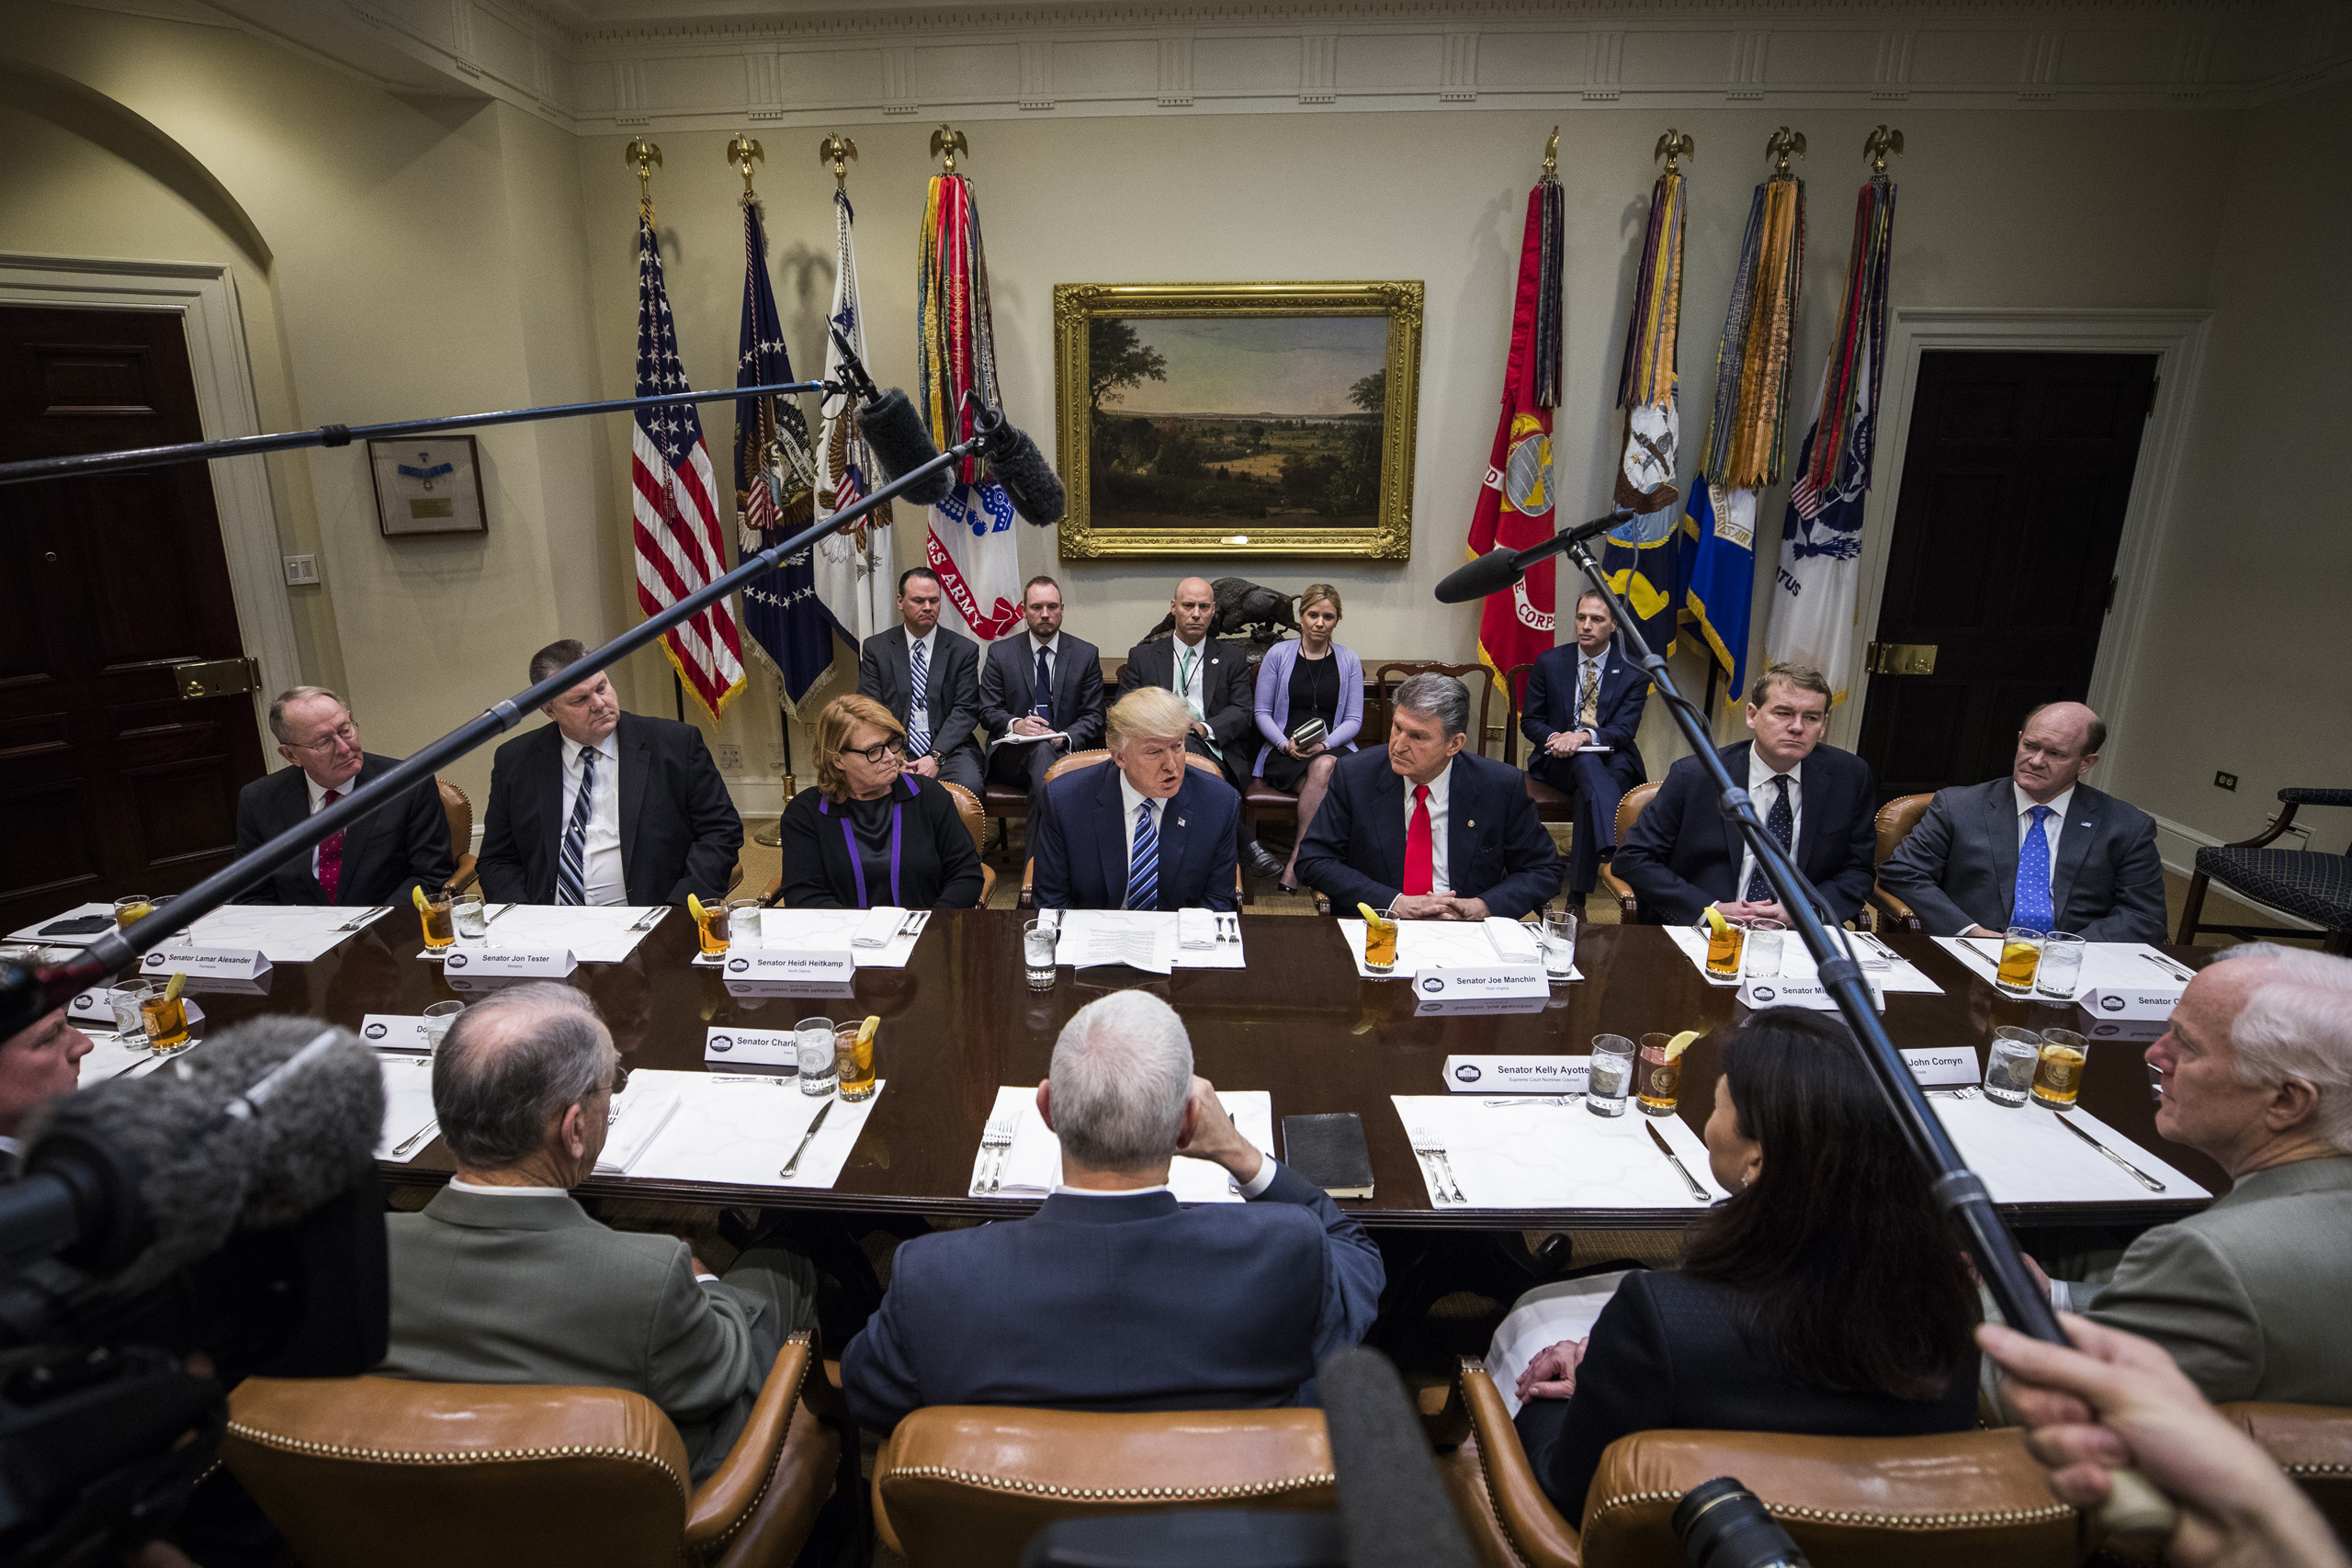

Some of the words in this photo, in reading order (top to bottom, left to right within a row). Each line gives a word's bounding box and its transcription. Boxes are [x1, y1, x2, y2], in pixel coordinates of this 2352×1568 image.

[954, 275, 964, 340] LEXINGTON
[955, 348, 964, 374] 1775
[941, 572, 984, 629] ARMY
[168, 953, 194, 963] Senator
[195, 954, 217, 964] Lamar
[218, 955, 252, 964] Alexander
[482, 954, 510, 963] Senator
[527, 954, 550, 963] Tester
[808, 960, 843, 968] Heitkamp
[1456, 976, 1487, 985] Senator
[1504, 976, 1536, 984] Manchin
[1781, 987, 1814, 995] Senator
[2138, 997, 2172, 1005] Senator
[737, 1037, 770, 1046] Senator
[1908, 1057, 1930, 1067] John
[1931, 1056, 1963, 1069] Cornyn
[1498, 1066, 1532, 1075] Senator
[1535, 1066, 1558, 1076] Kelly
[1560, 1066, 1590, 1076] Ayotte
